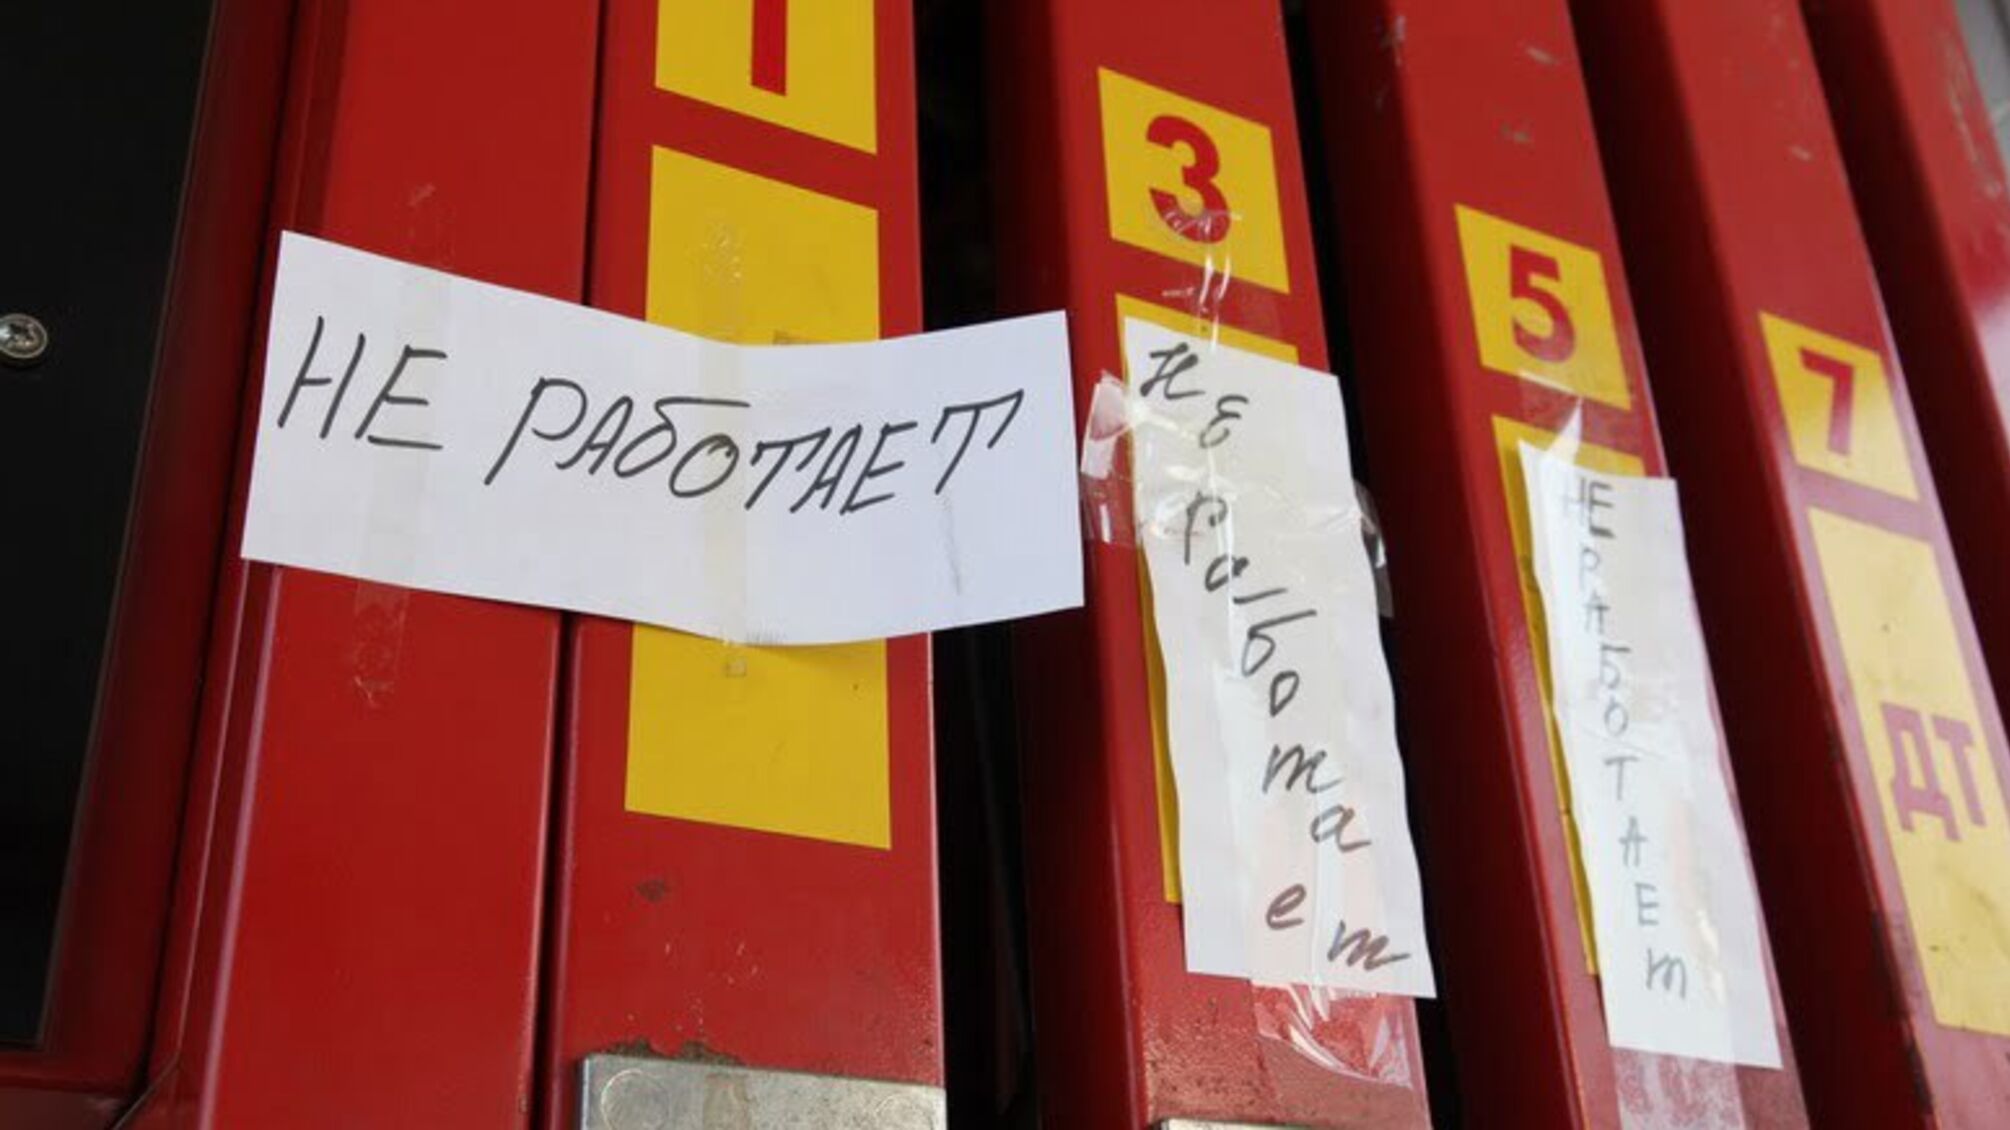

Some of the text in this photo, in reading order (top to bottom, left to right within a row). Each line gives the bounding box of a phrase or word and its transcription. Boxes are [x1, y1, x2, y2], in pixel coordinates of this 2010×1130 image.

[1145, 113, 1231, 245] 3
[1508, 242, 1577, 364] 5
[276, 316, 448, 451] НЕ
[1797, 345, 1855, 458] 7
[1562, 476, 1616, 540] НЕ
[1880, 700, 1988, 844] ДТ
